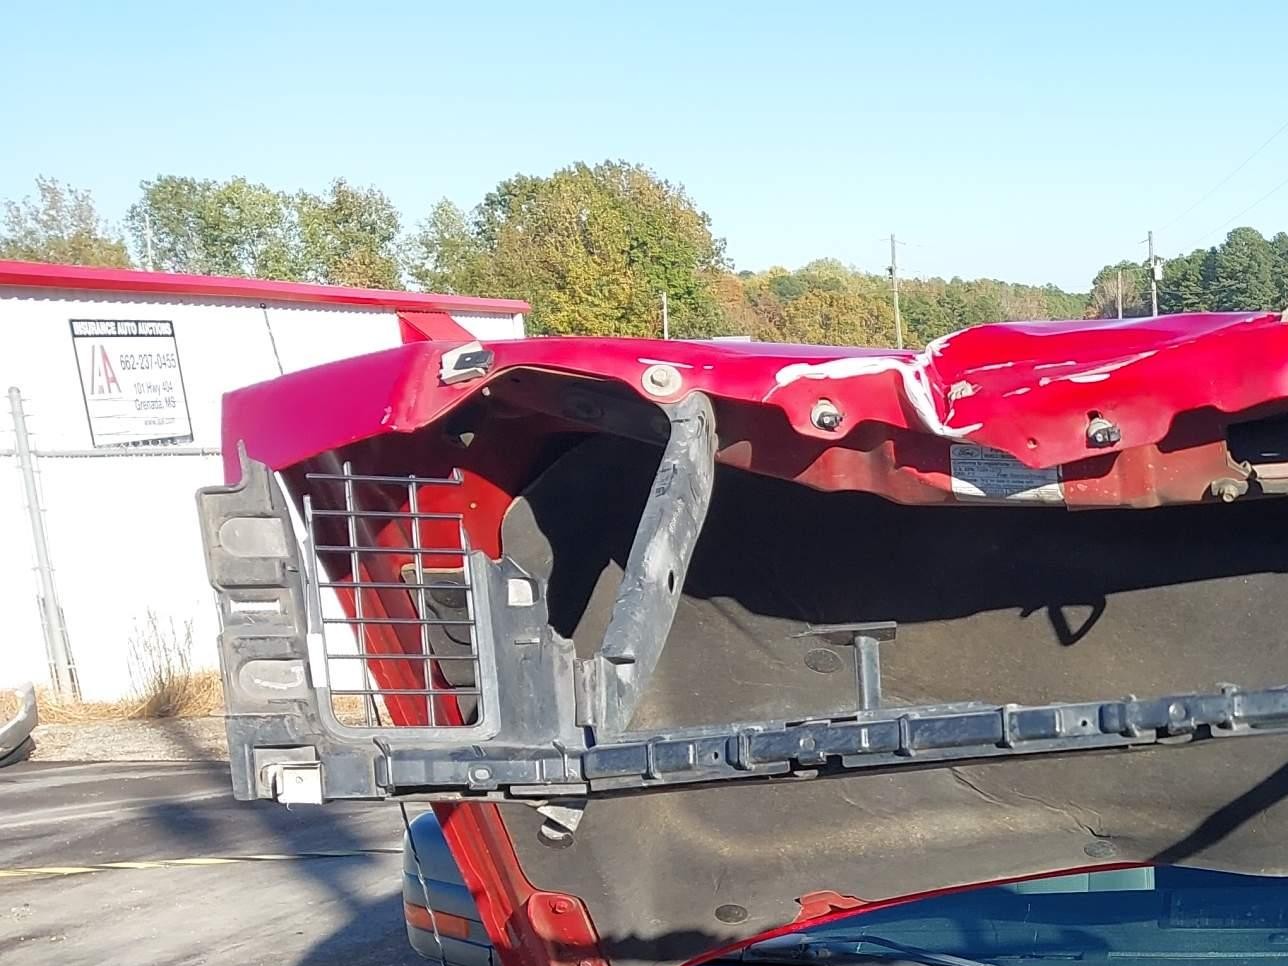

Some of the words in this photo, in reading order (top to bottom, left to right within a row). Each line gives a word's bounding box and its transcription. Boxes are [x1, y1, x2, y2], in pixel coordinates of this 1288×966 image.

[72, 321, 116, 336] INSURANCE
[117, 321, 137, 336] AUTO
[138, 322, 173, 336] AUCTIONS
[120, 353, 176, 370] 662-237-0455
[147, 381, 161, 396] Hwy
